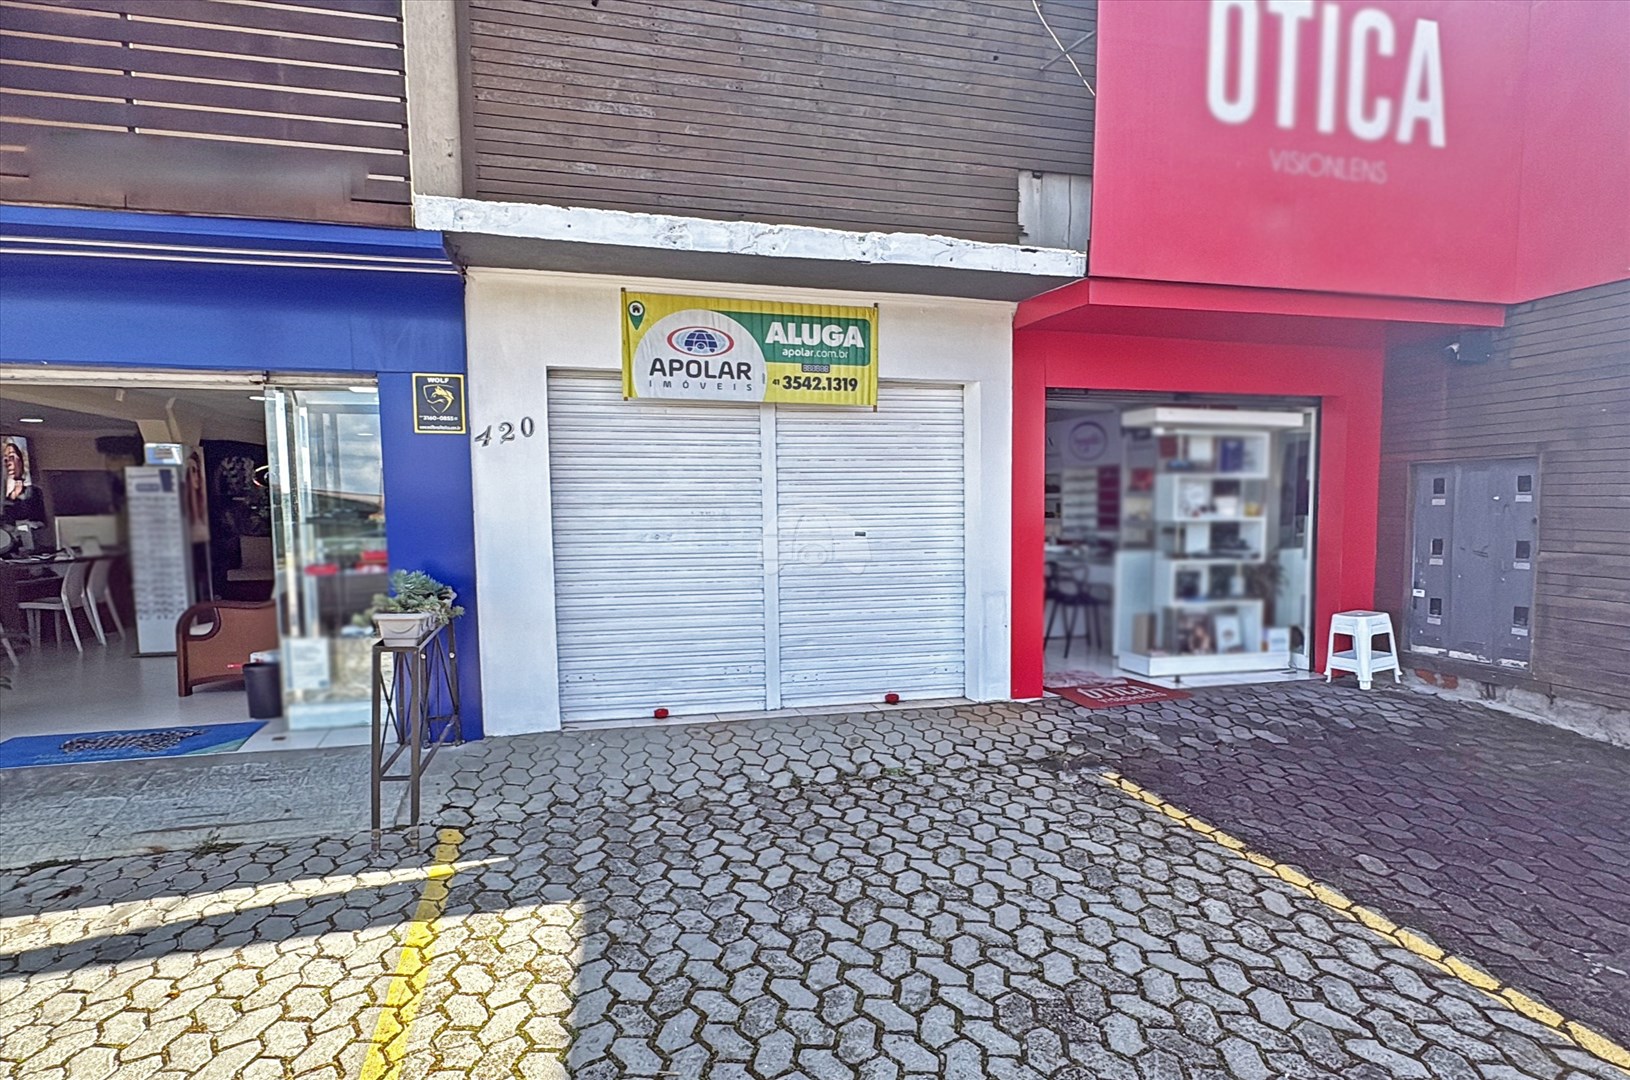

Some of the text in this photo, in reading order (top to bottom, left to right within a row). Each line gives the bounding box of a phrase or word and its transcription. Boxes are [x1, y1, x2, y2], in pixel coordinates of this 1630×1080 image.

[765, 321, 865, 349] ALUGA
[782, 347, 849, 360] apolar.com.br
[649, 357, 752, 380] APOLAR
[782, 375, 858, 392] 3542.1319
[474, 416, 535, 447] 420
